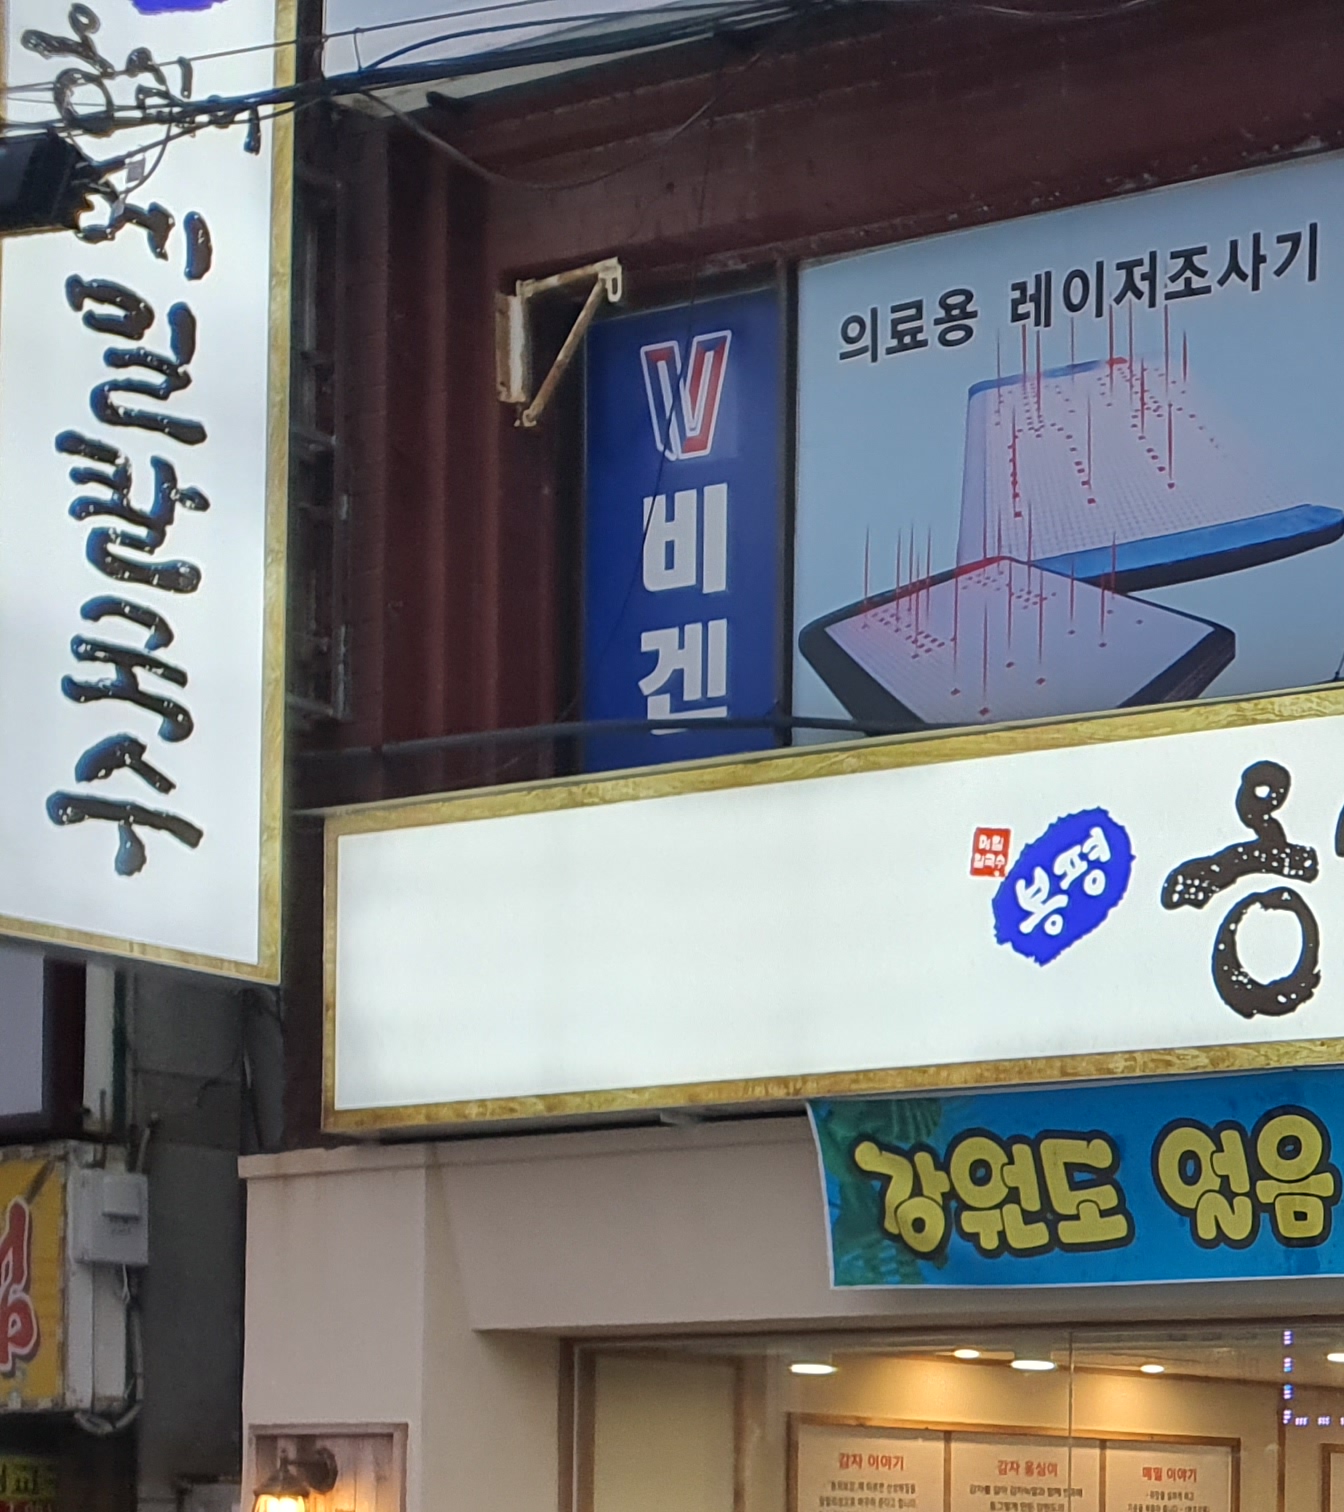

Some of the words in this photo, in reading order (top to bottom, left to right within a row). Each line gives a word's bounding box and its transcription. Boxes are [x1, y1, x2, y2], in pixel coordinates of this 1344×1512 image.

[839, 287, 978, 364] 의료용
[1009, 223, 1319, 329] 레이저조사기
[1015, 826, 1111, 936] 봉평
[854, 1132, 1133, 1256] 강원도
[1155, 1106, 1341, 1250] 얼음
